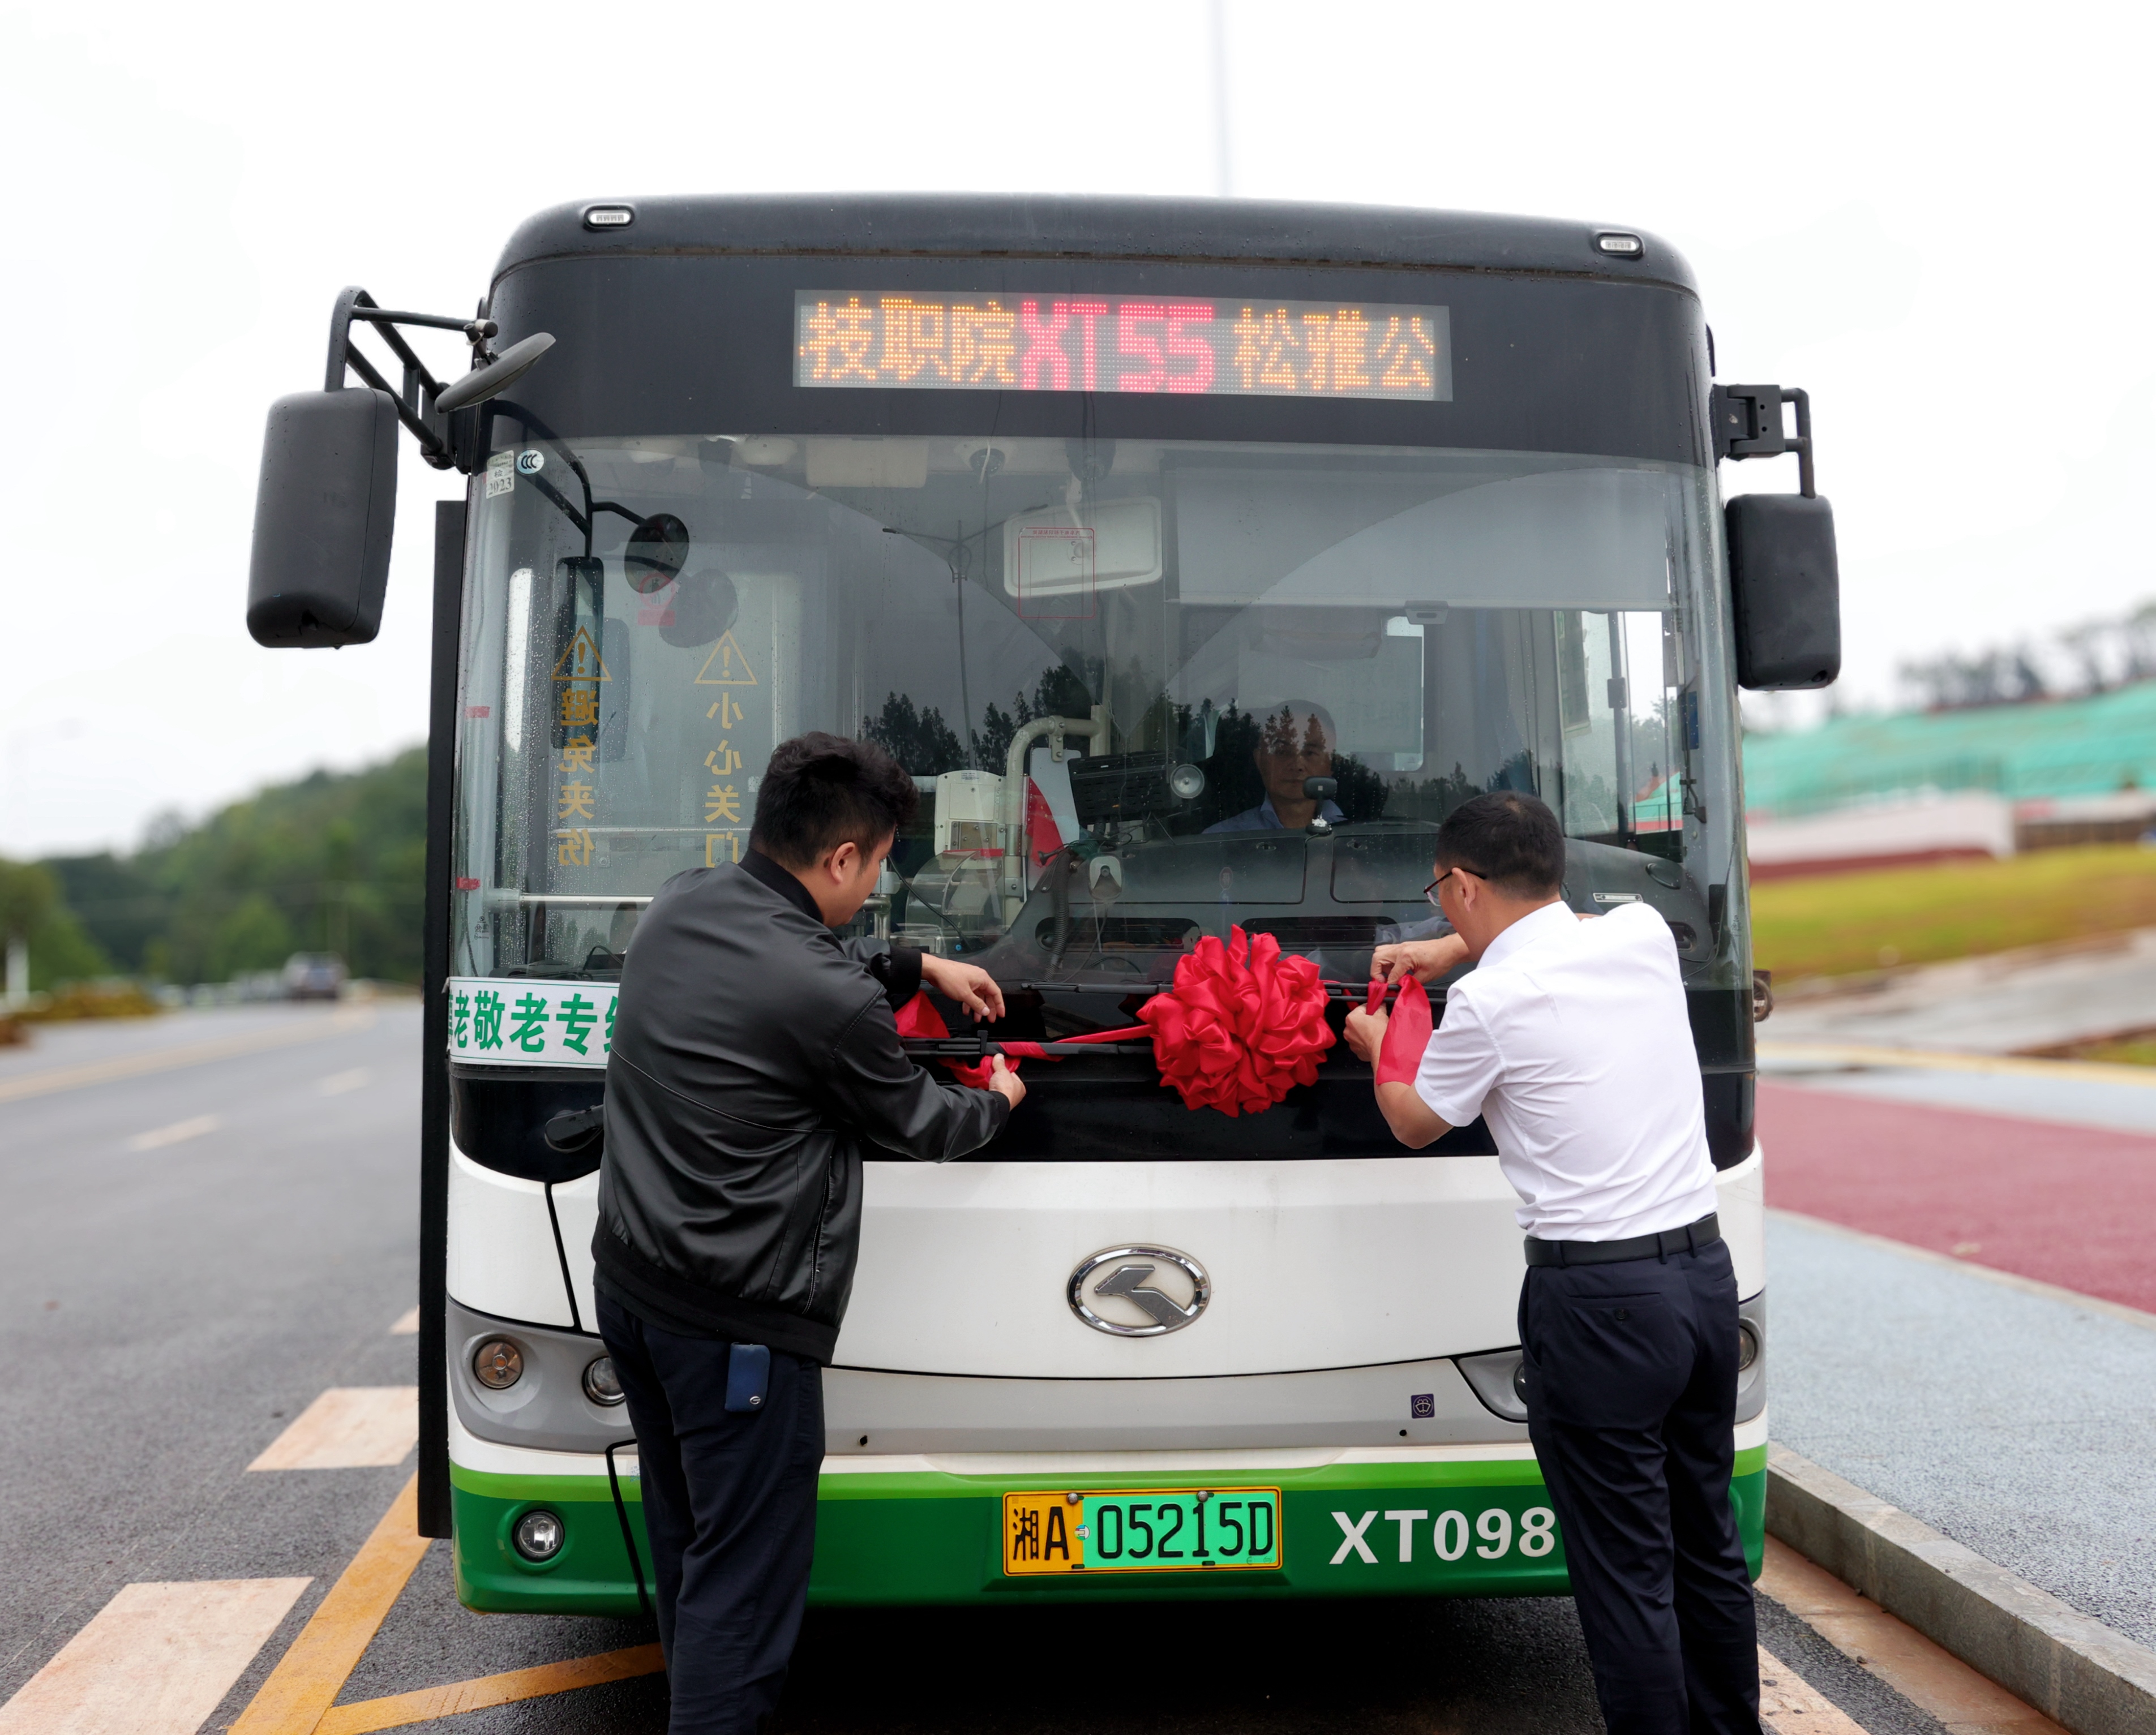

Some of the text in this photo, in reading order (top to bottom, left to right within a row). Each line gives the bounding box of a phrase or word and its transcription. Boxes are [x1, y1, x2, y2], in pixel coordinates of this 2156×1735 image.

[809, 298, 1015, 382] 技职院
[1023, 302, 1214, 392] XT55
[488, 477, 512, 496] 2023
[448, 989, 618, 1056] 老敬老专
[1329, 1507, 1556, 1564] XT098
